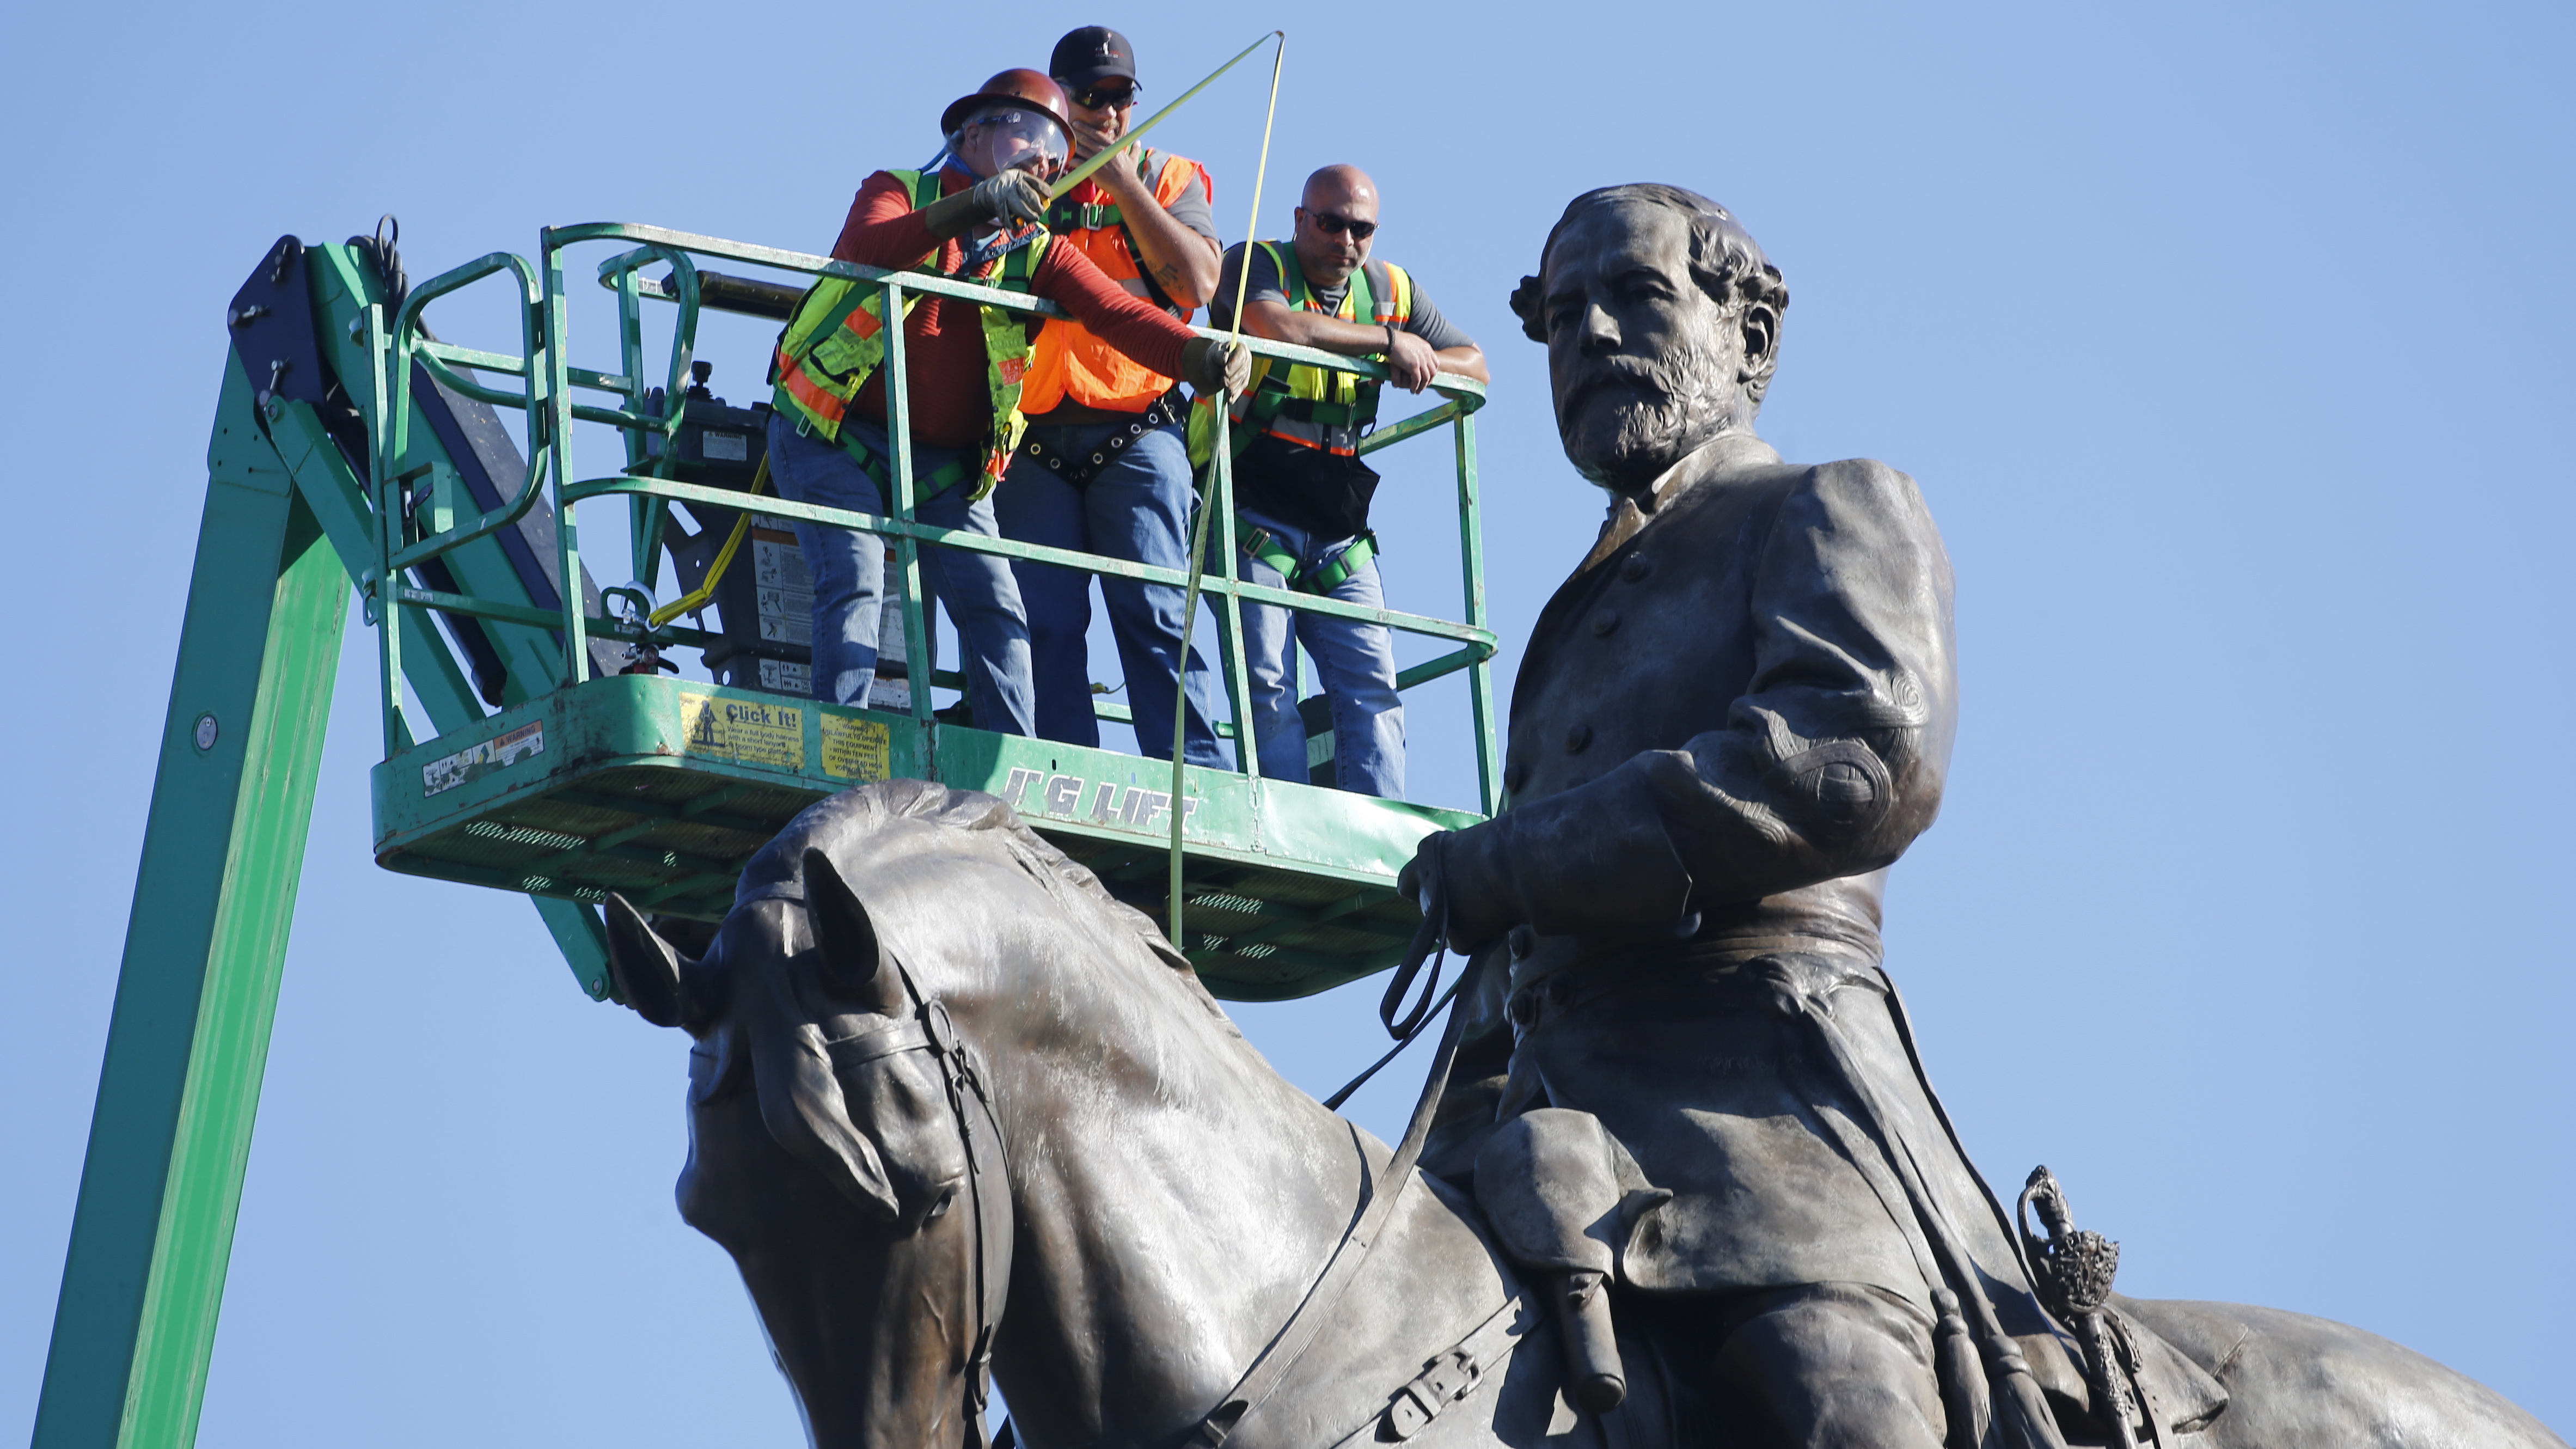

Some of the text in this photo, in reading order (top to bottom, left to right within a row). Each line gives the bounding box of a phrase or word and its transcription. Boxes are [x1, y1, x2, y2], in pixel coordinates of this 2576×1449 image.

[726, 704, 797, 727] Click It!
[842, 723, 868, 732] WARNING
[506, 725, 536, 743] WARNING
[761, 731, 775, 739] body
[775, 733, 799, 743] harness
[747, 736, 762, 744] short
[833, 747, 851, 755] WITHIN
[846, 741, 877, 751] EQUIPMENT
[1090, 781, 1198, 835] LIFT
